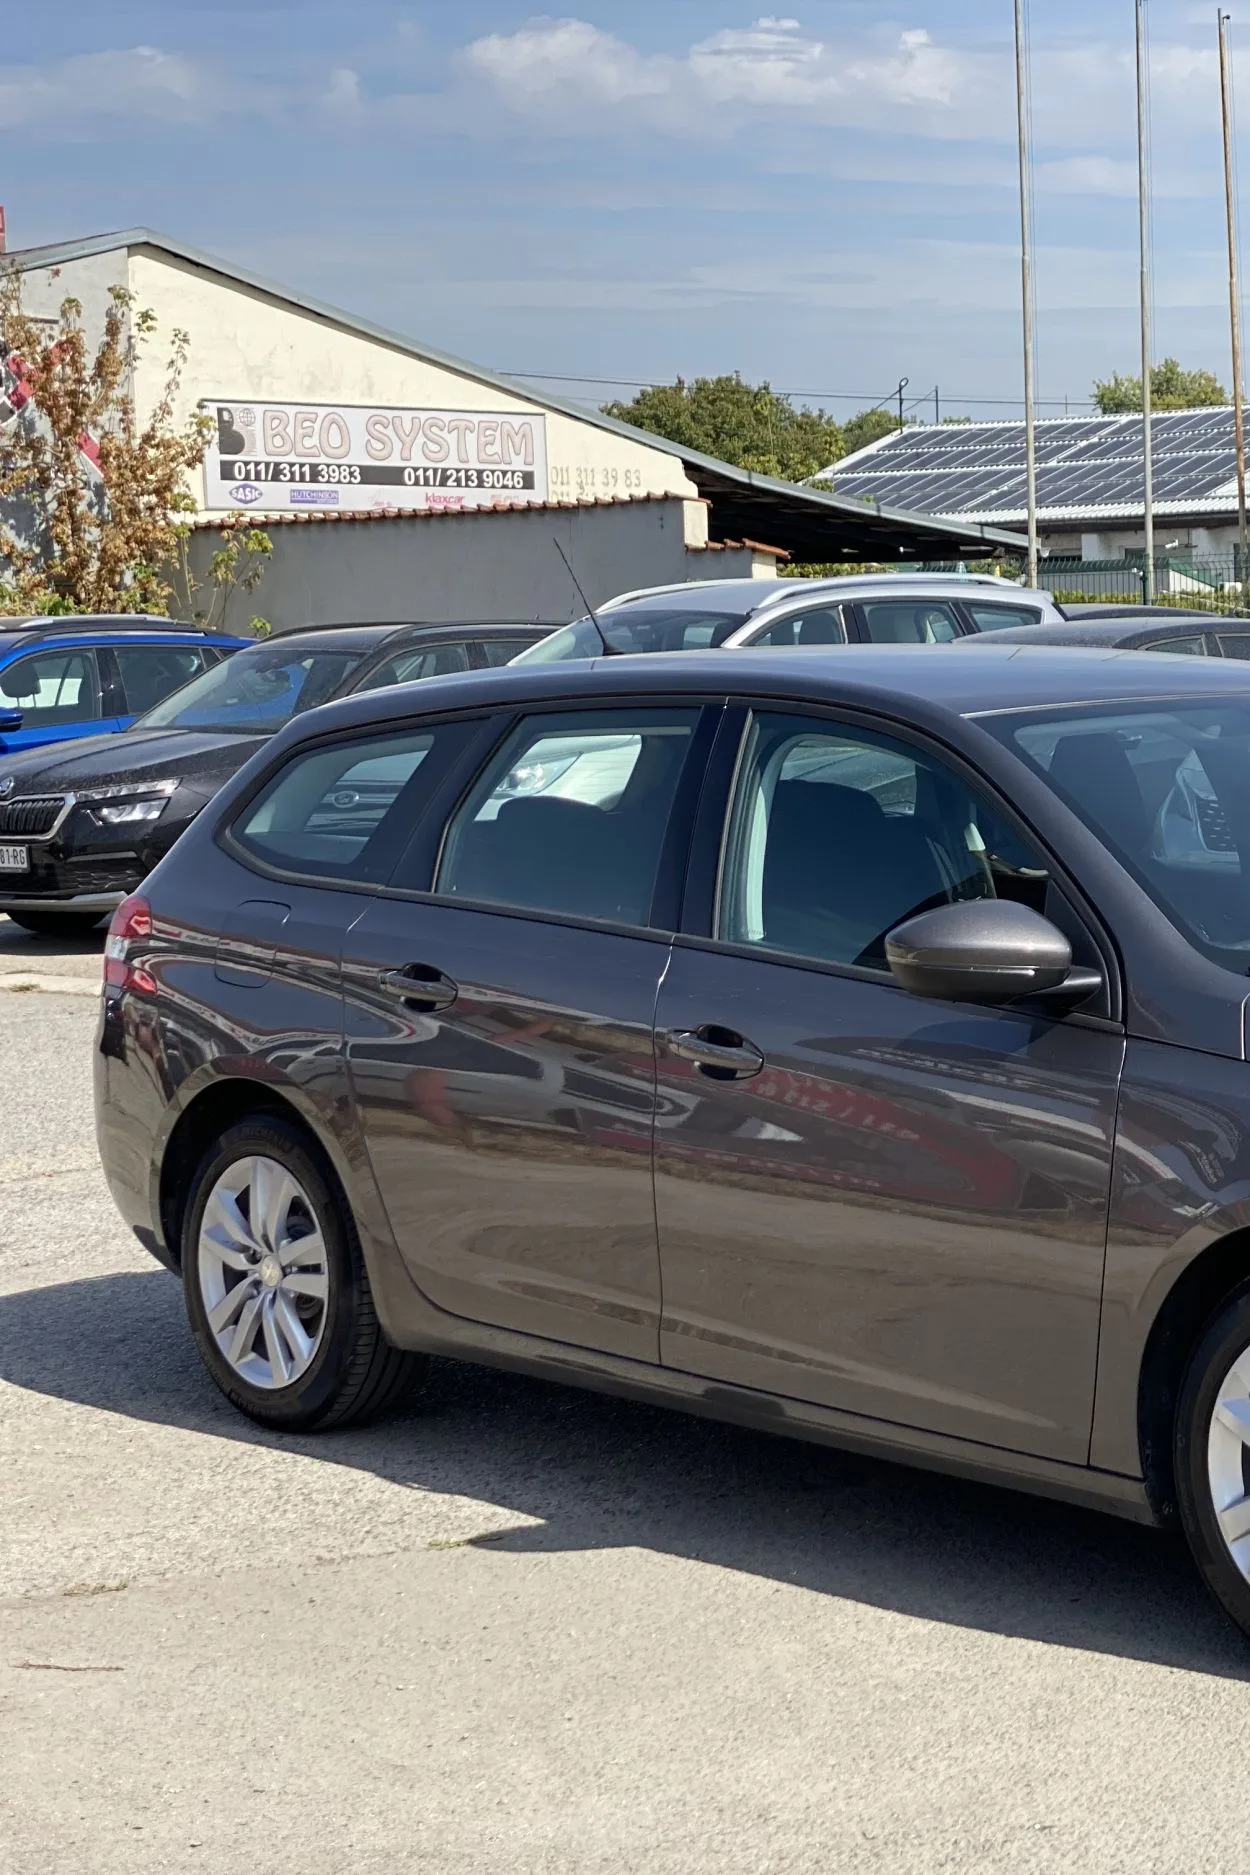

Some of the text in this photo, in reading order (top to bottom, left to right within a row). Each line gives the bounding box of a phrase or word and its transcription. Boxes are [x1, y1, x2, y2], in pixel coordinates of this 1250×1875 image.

[262, 409, 535, 466] BEO SYSTEM
[233, 461, 361, 484] 011/ 311 3983
[404, 467, 524, 489] 011/ 213 9046
[550, 466, 641, 489] 011 311 39 83
[231, 487, 261, 501] SASIC
